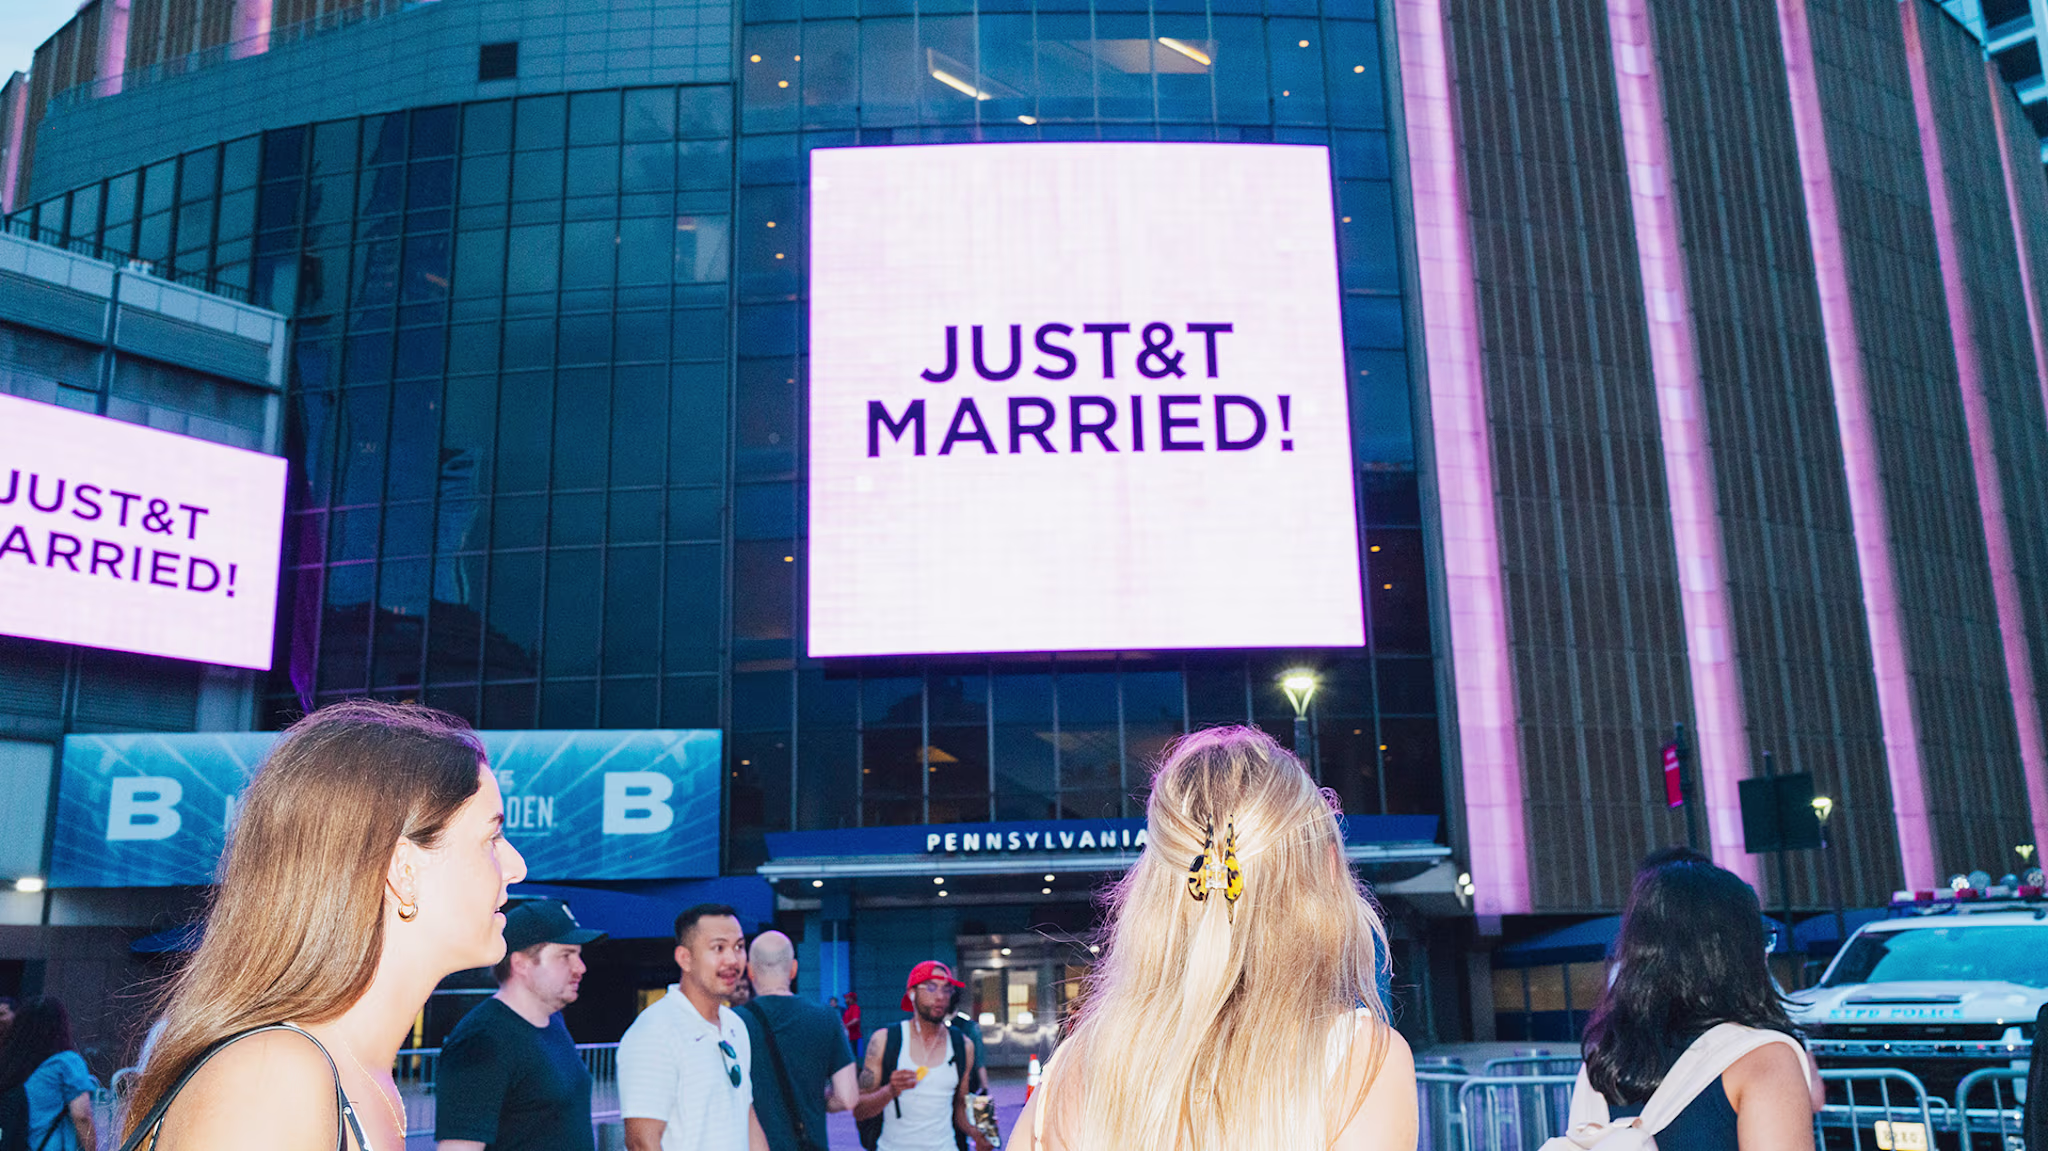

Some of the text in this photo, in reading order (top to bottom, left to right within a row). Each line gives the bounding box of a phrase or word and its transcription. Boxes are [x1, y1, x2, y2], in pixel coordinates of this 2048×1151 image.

[920, 321, 1234, 383] JUST&T
[867, 393, 1294, 457] MARRIED!
[0, 468, 209, 540] JUST&T
[106, 775, 183, 840] B
[602, 770, 674, 835] B
[926, 828, 1148, 852] PENNSYLVANIA
[1890, 1007, 1965, 1020] POLICE
